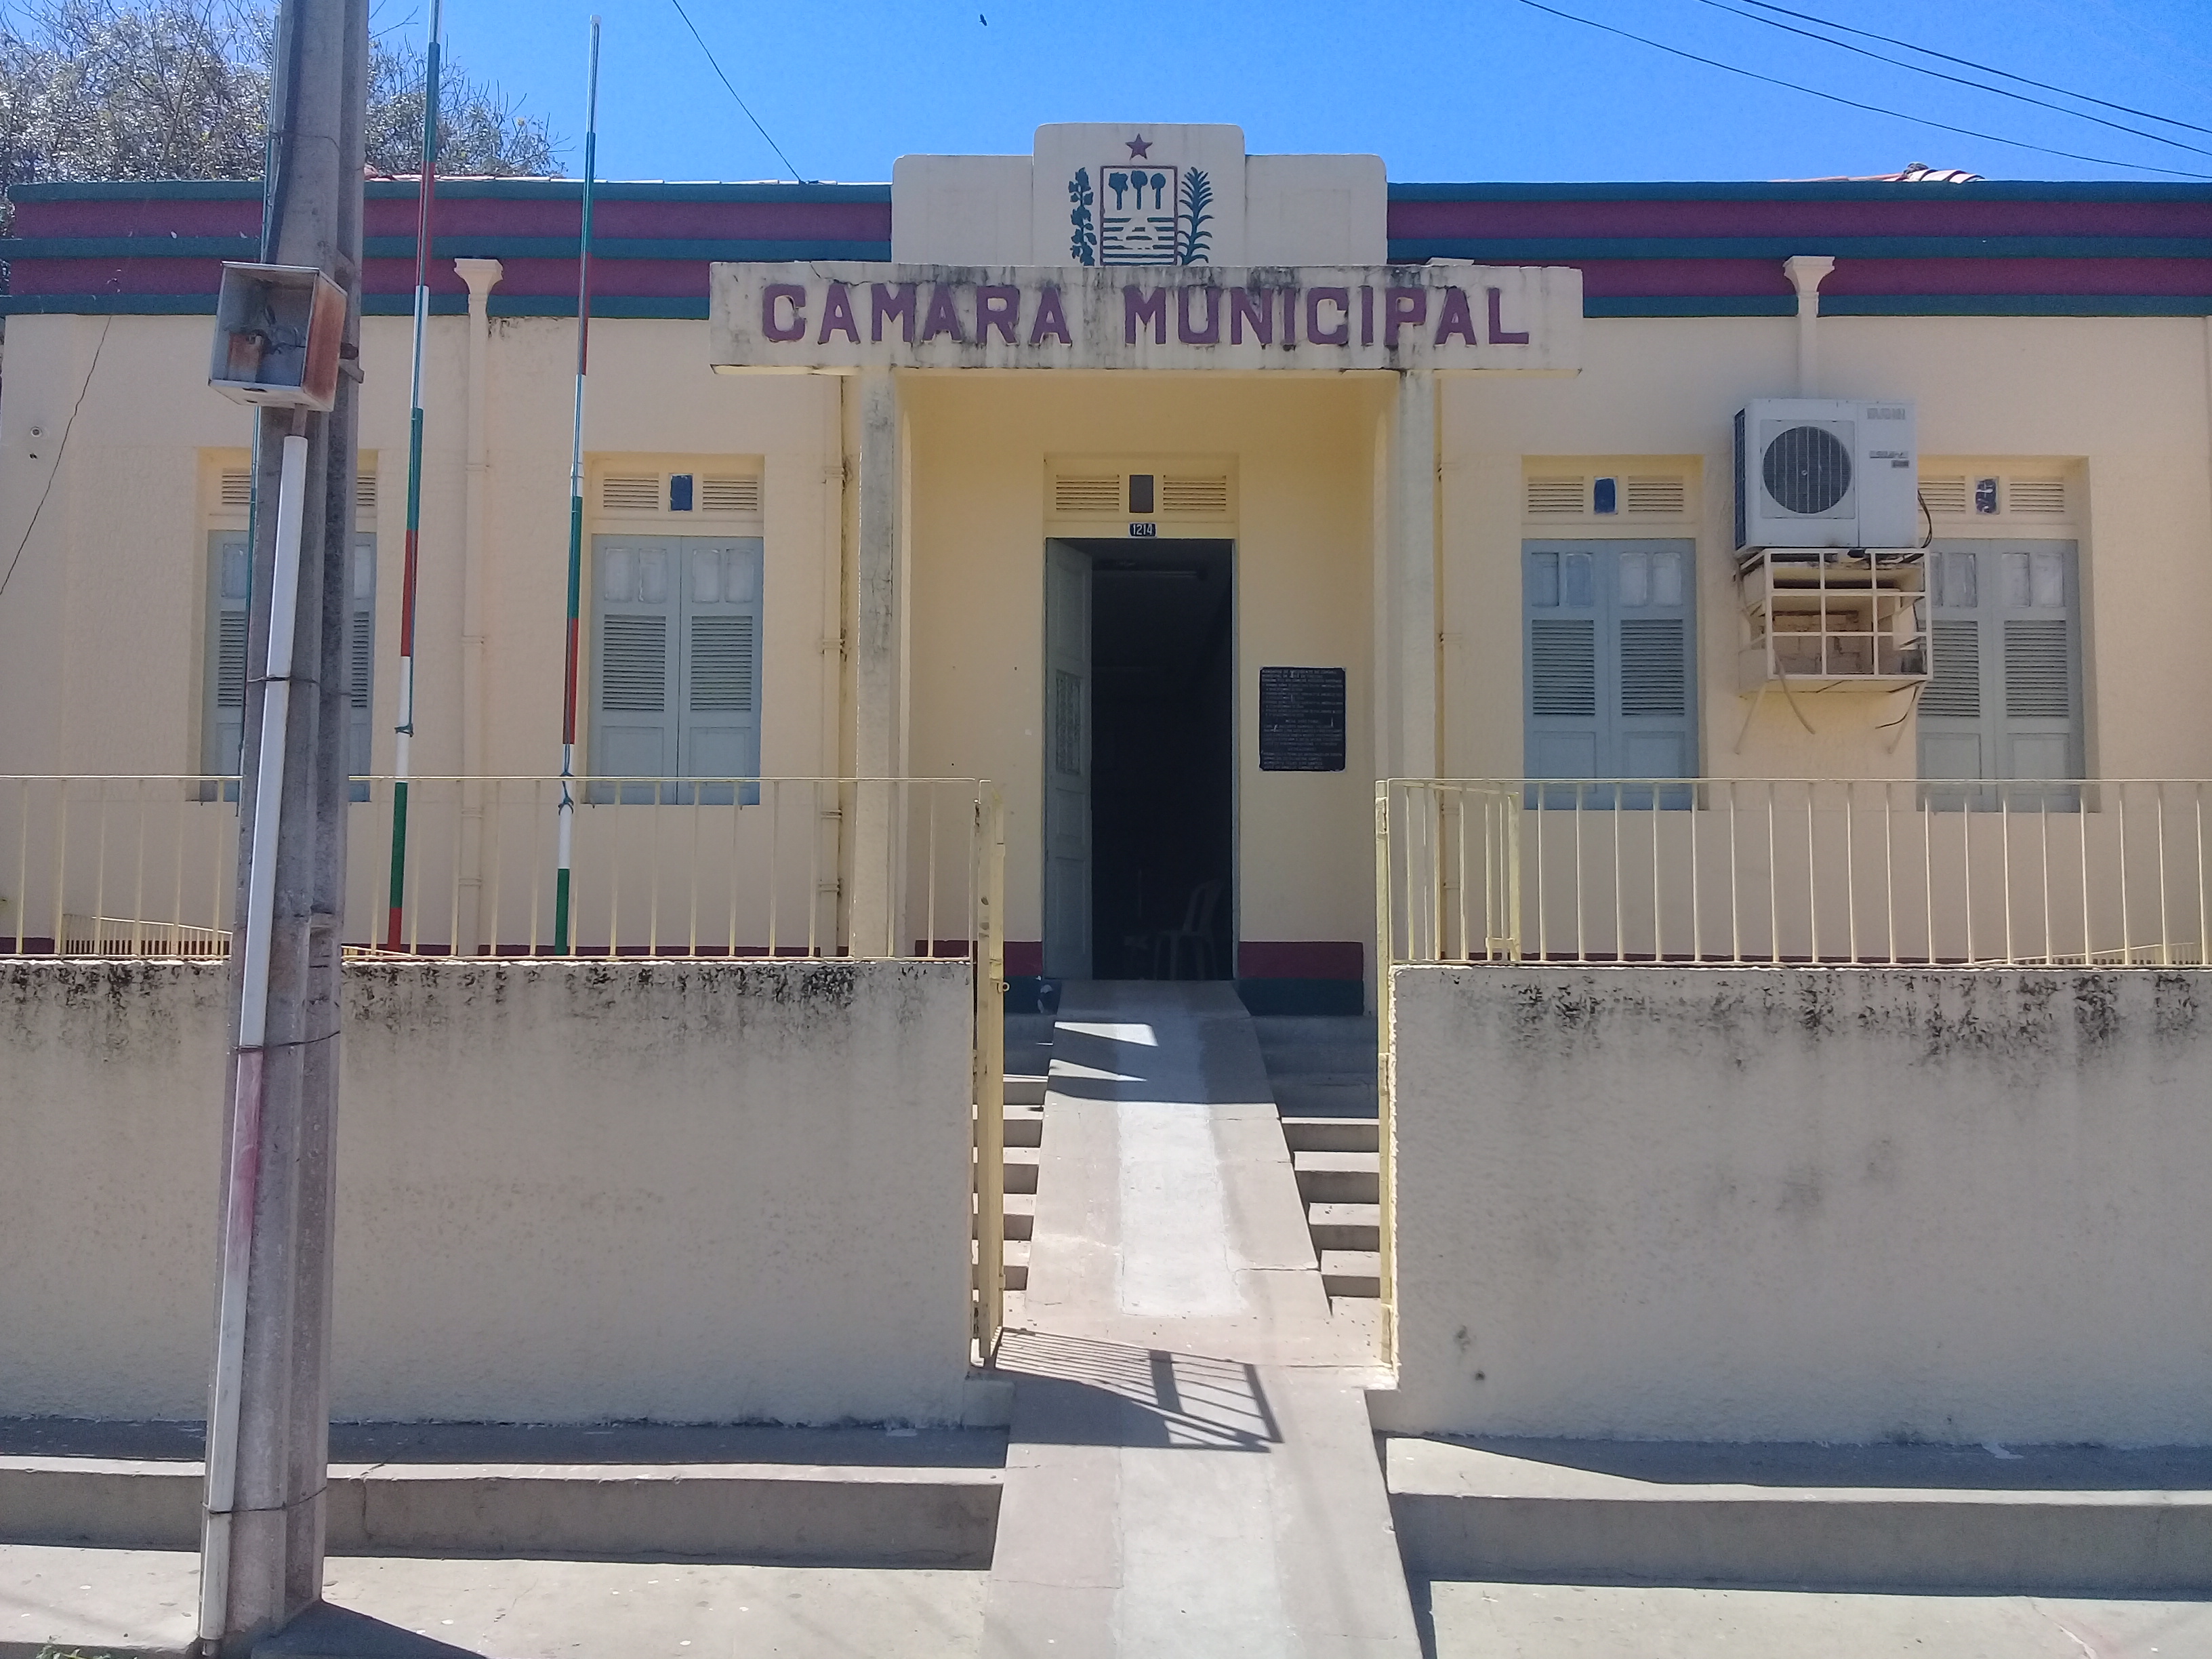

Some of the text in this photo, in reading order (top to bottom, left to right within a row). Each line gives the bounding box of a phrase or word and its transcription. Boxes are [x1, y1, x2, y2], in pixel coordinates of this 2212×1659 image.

[762, 283, 1530, 346] CAMARA MUNICIPAL
[1132, 524, 1153, 535] 1214
